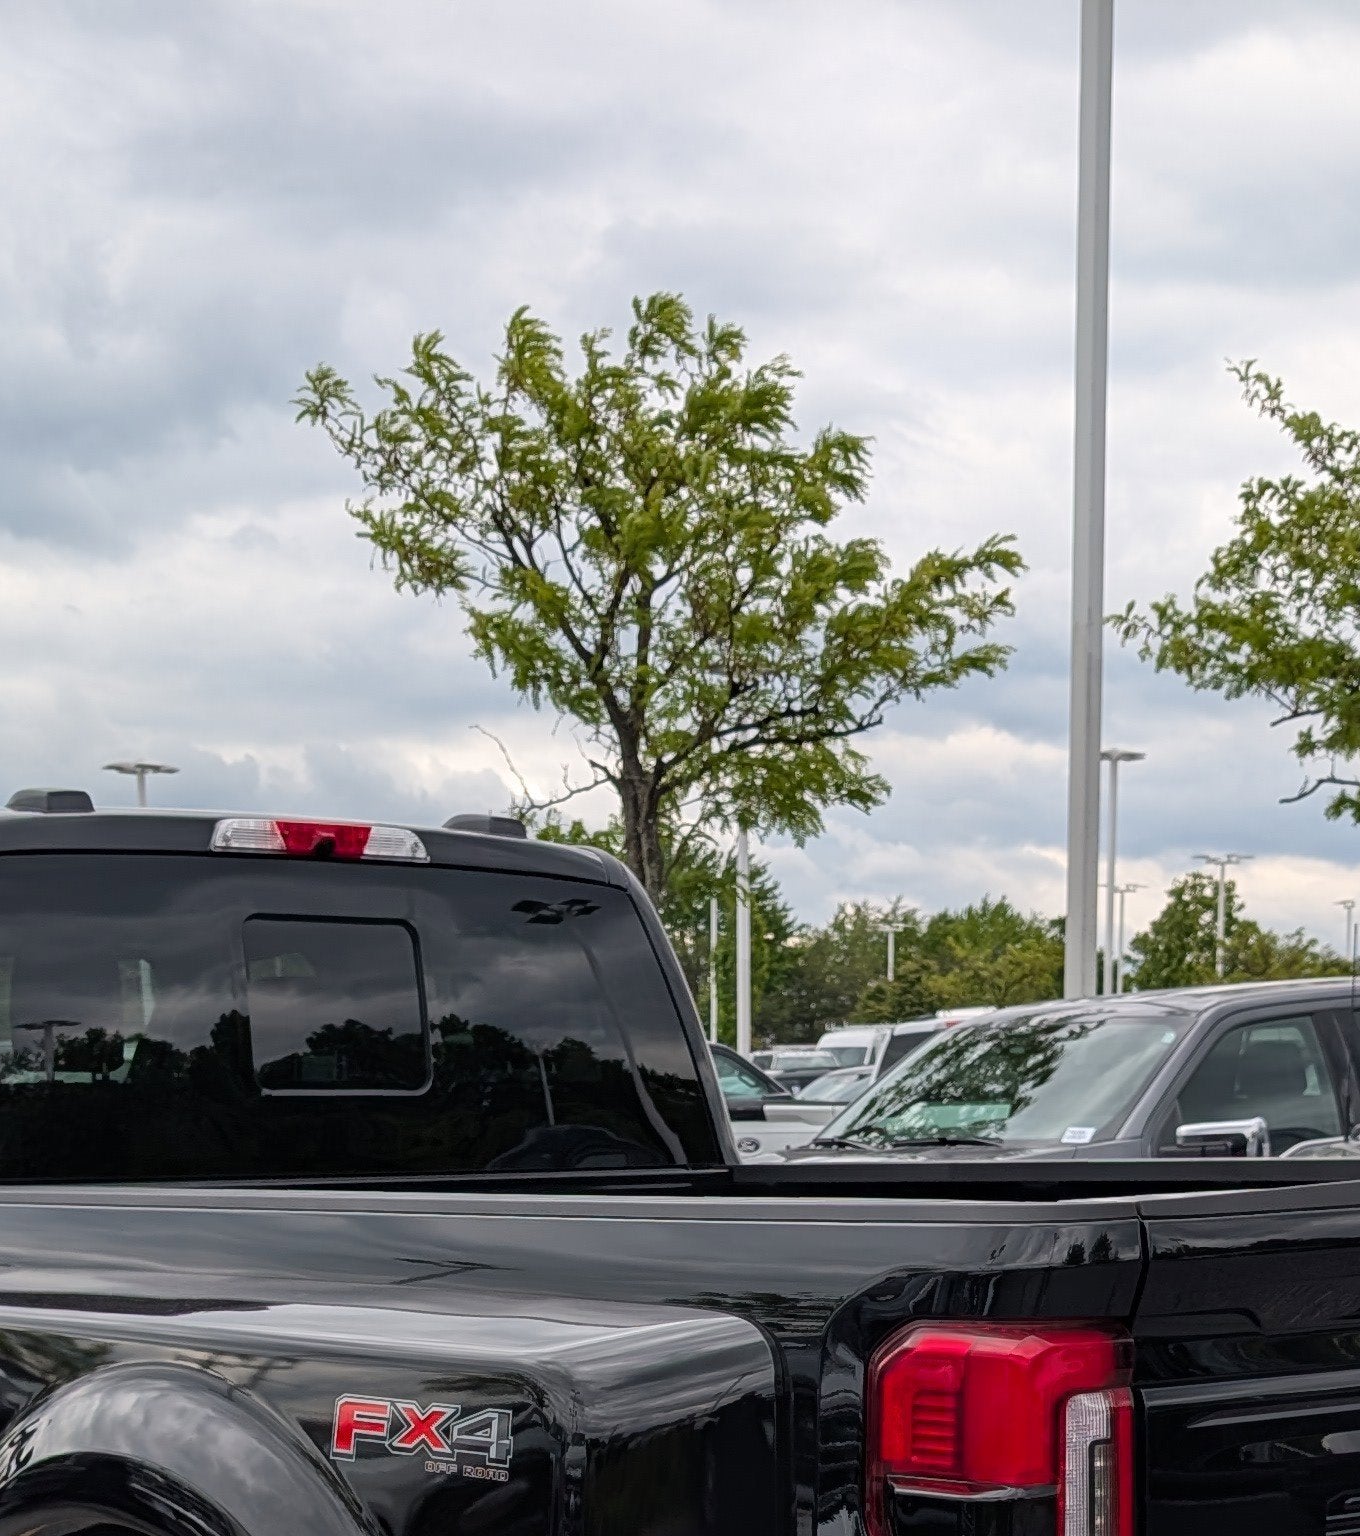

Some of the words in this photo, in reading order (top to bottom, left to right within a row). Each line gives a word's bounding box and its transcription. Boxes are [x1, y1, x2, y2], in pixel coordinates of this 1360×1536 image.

[330, 1393, 514, 1468] FX4
[424, 1460, 458, 1475] OFF
[462, 1465, 509, 1482] ROAD
